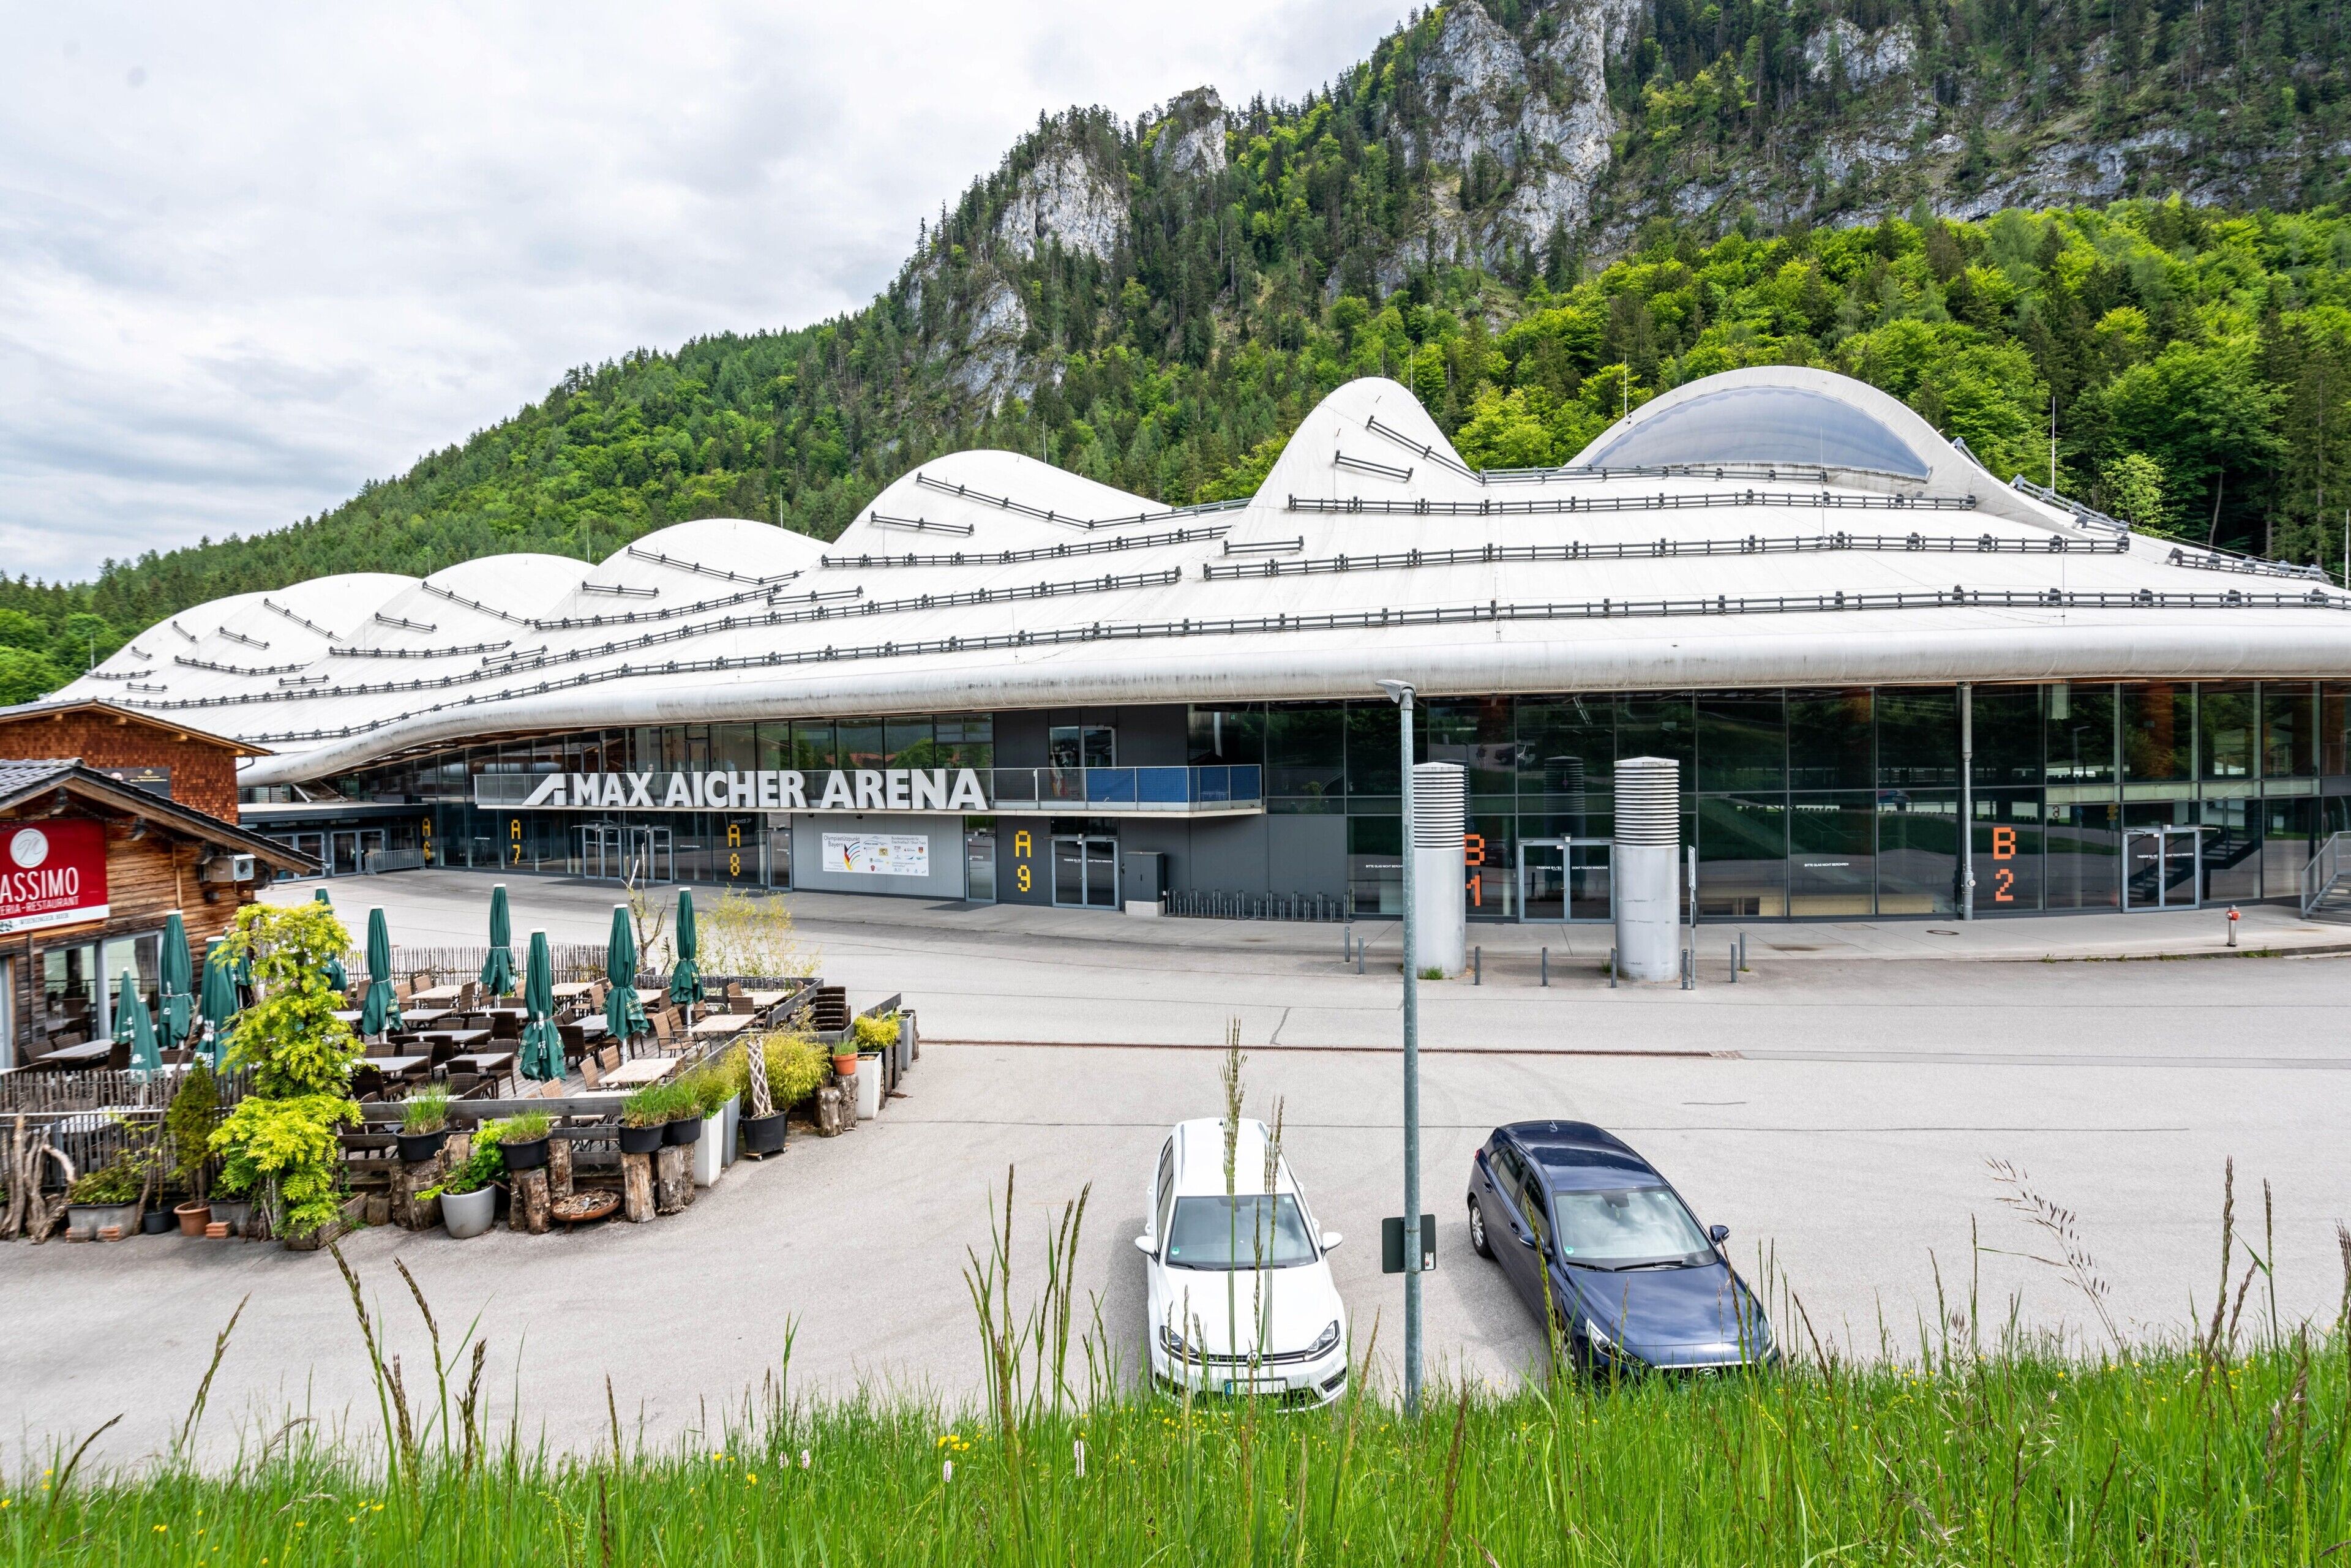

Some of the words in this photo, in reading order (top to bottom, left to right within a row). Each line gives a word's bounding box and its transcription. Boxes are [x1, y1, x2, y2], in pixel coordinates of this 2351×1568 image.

[573, 773, 654, 806] MAX
[664, 771, 808, 808] AICHER
[820, 768, 988, 810] ARENA
[511, 820, 520, 839] A
[729, 824, 740, 847] A
[513, 845, 520, 865] 7
[1016, 830, 1031, 857] A
[1993, 827, 2015, 860] B
[730, 853, 740, 876] 8
[1018, 865, 1030, 891] 9
[1466, 875, 1480, 906] 1
[1996, 869, 2013, 901] 2
